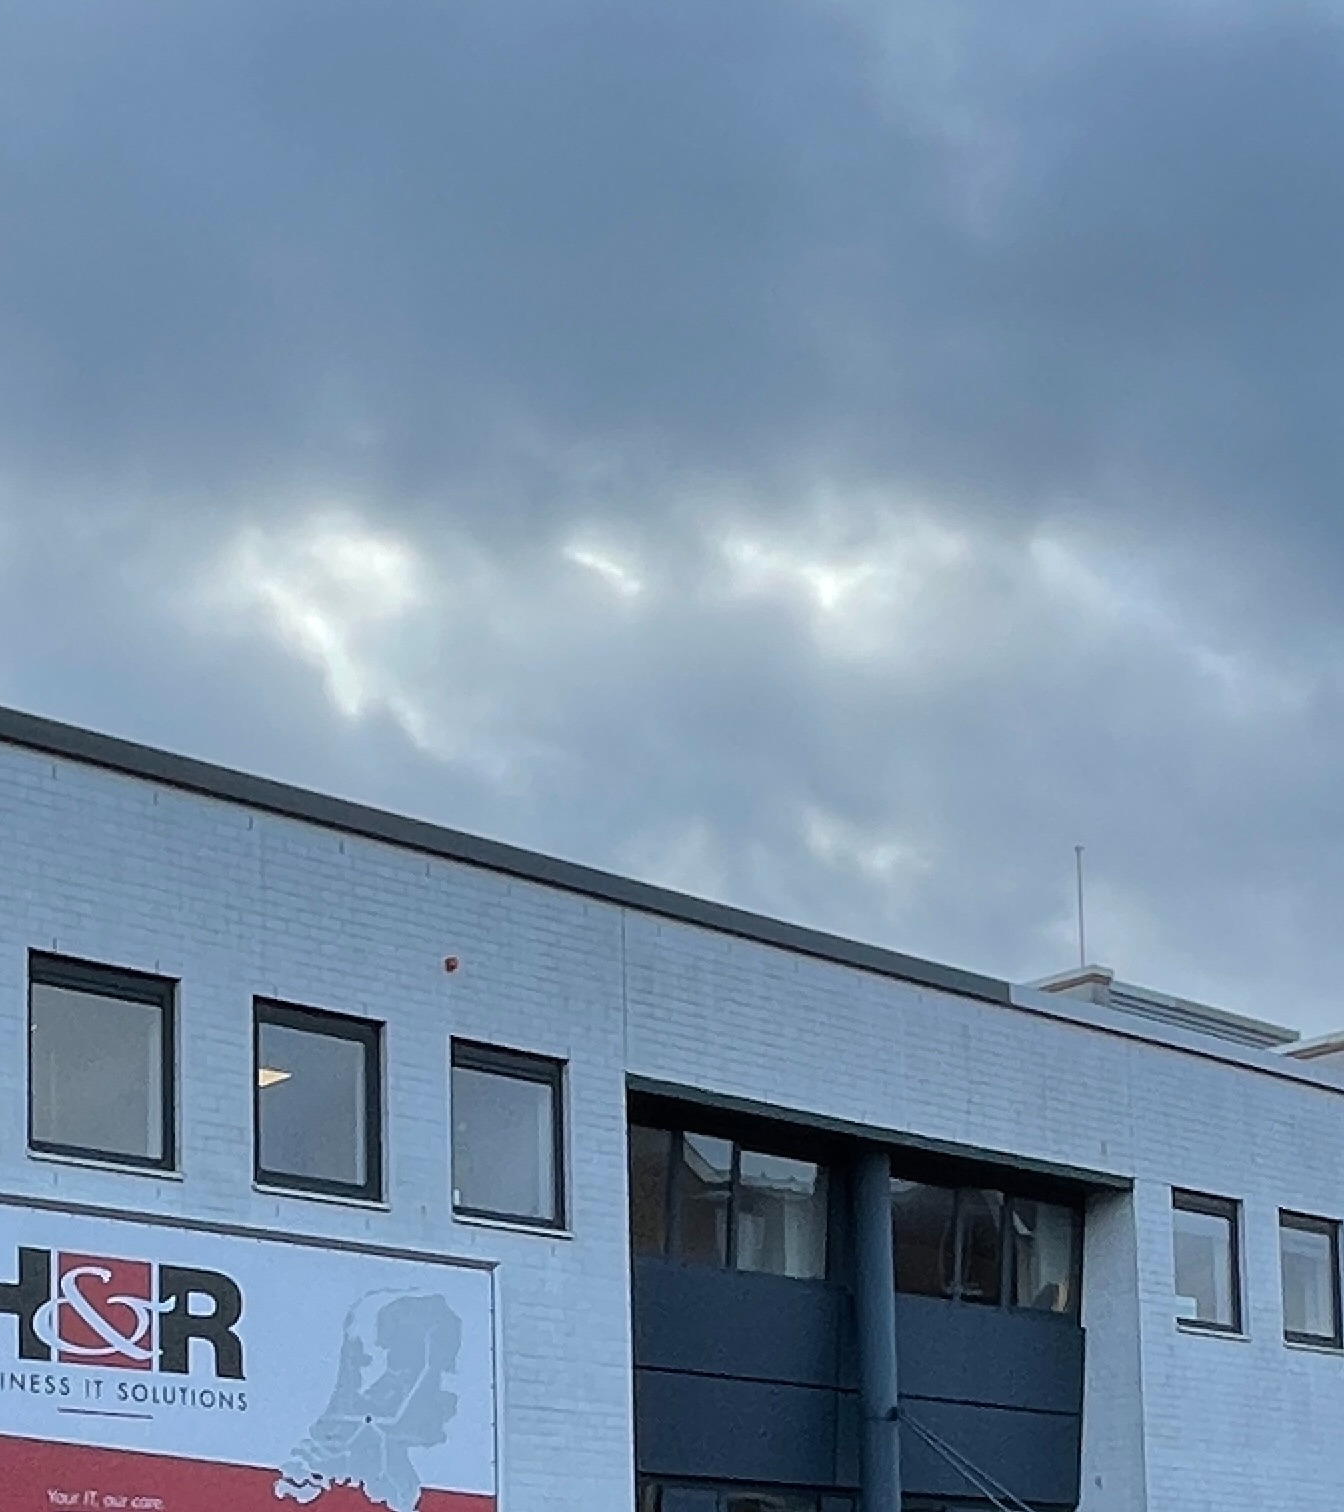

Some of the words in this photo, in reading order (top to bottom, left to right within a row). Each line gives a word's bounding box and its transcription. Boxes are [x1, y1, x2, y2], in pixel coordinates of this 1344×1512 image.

[84, 1379, 104, 1399] IT
[117, 1382, 248, 1412] SOLUTIONS
[46, 1487, 80, 1506] Your
[102, 1493, 128, 1508] our
